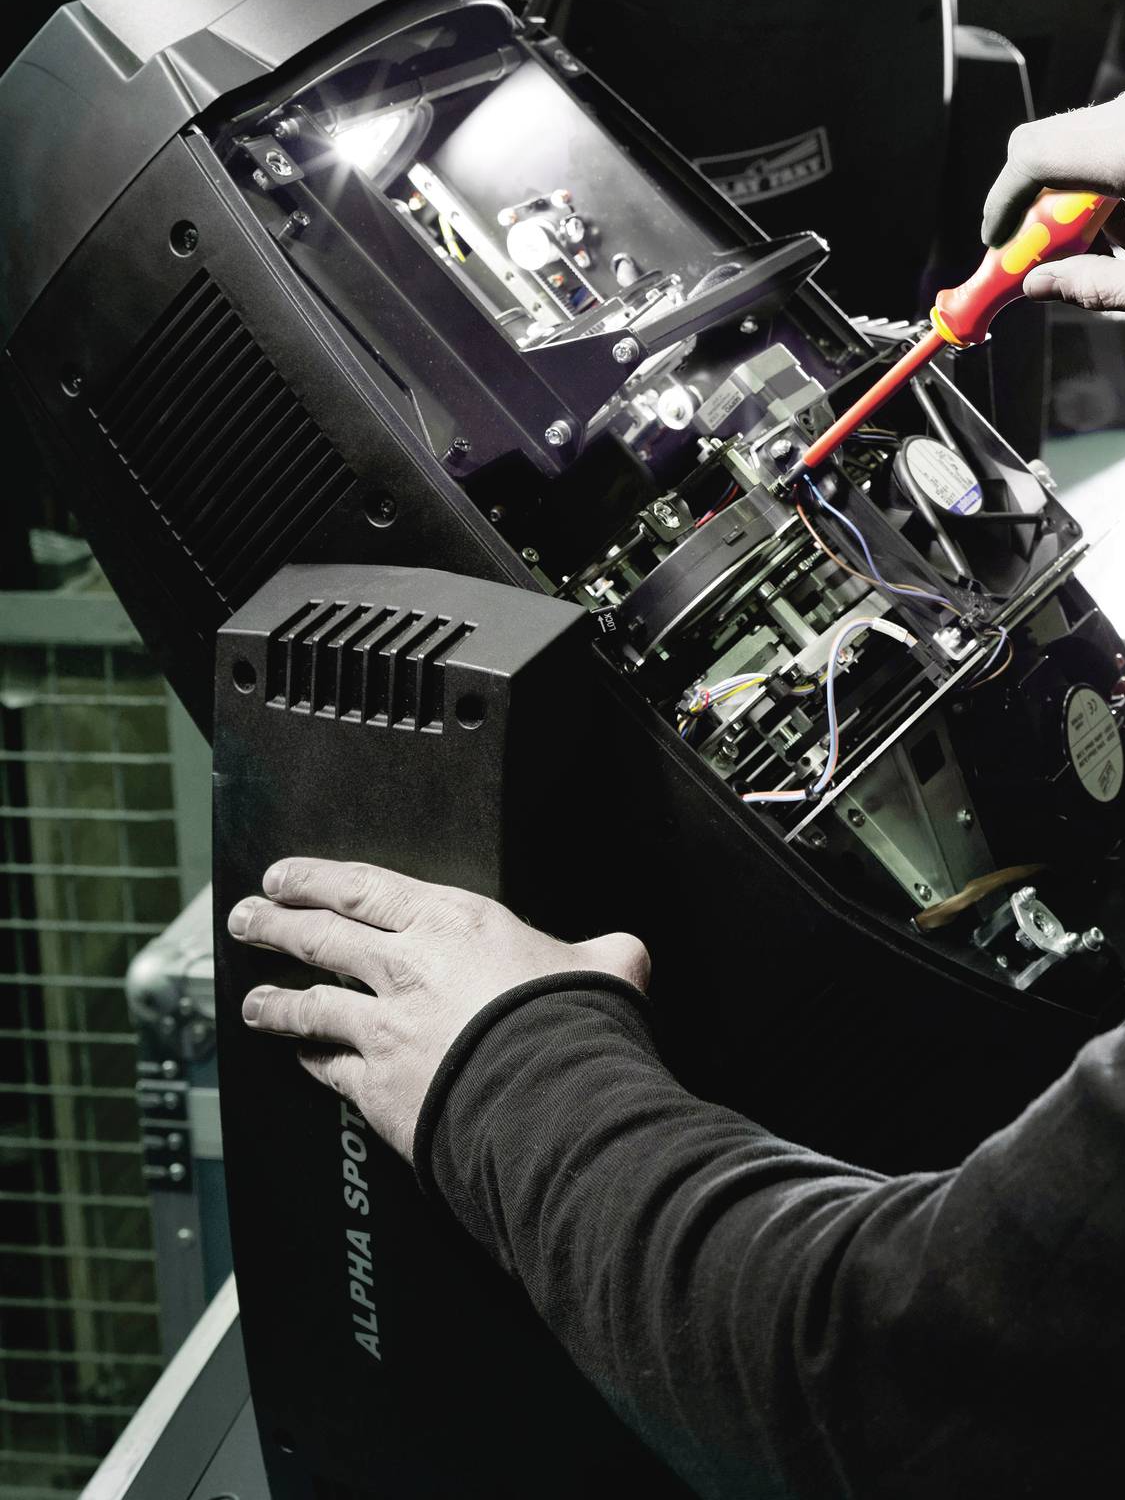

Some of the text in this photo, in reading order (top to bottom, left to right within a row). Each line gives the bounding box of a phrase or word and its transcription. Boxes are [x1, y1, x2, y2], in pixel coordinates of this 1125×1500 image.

[603, 612, 617, 632] LOCK
[340, 1101, 382, 1361] ALPHA SPOT
